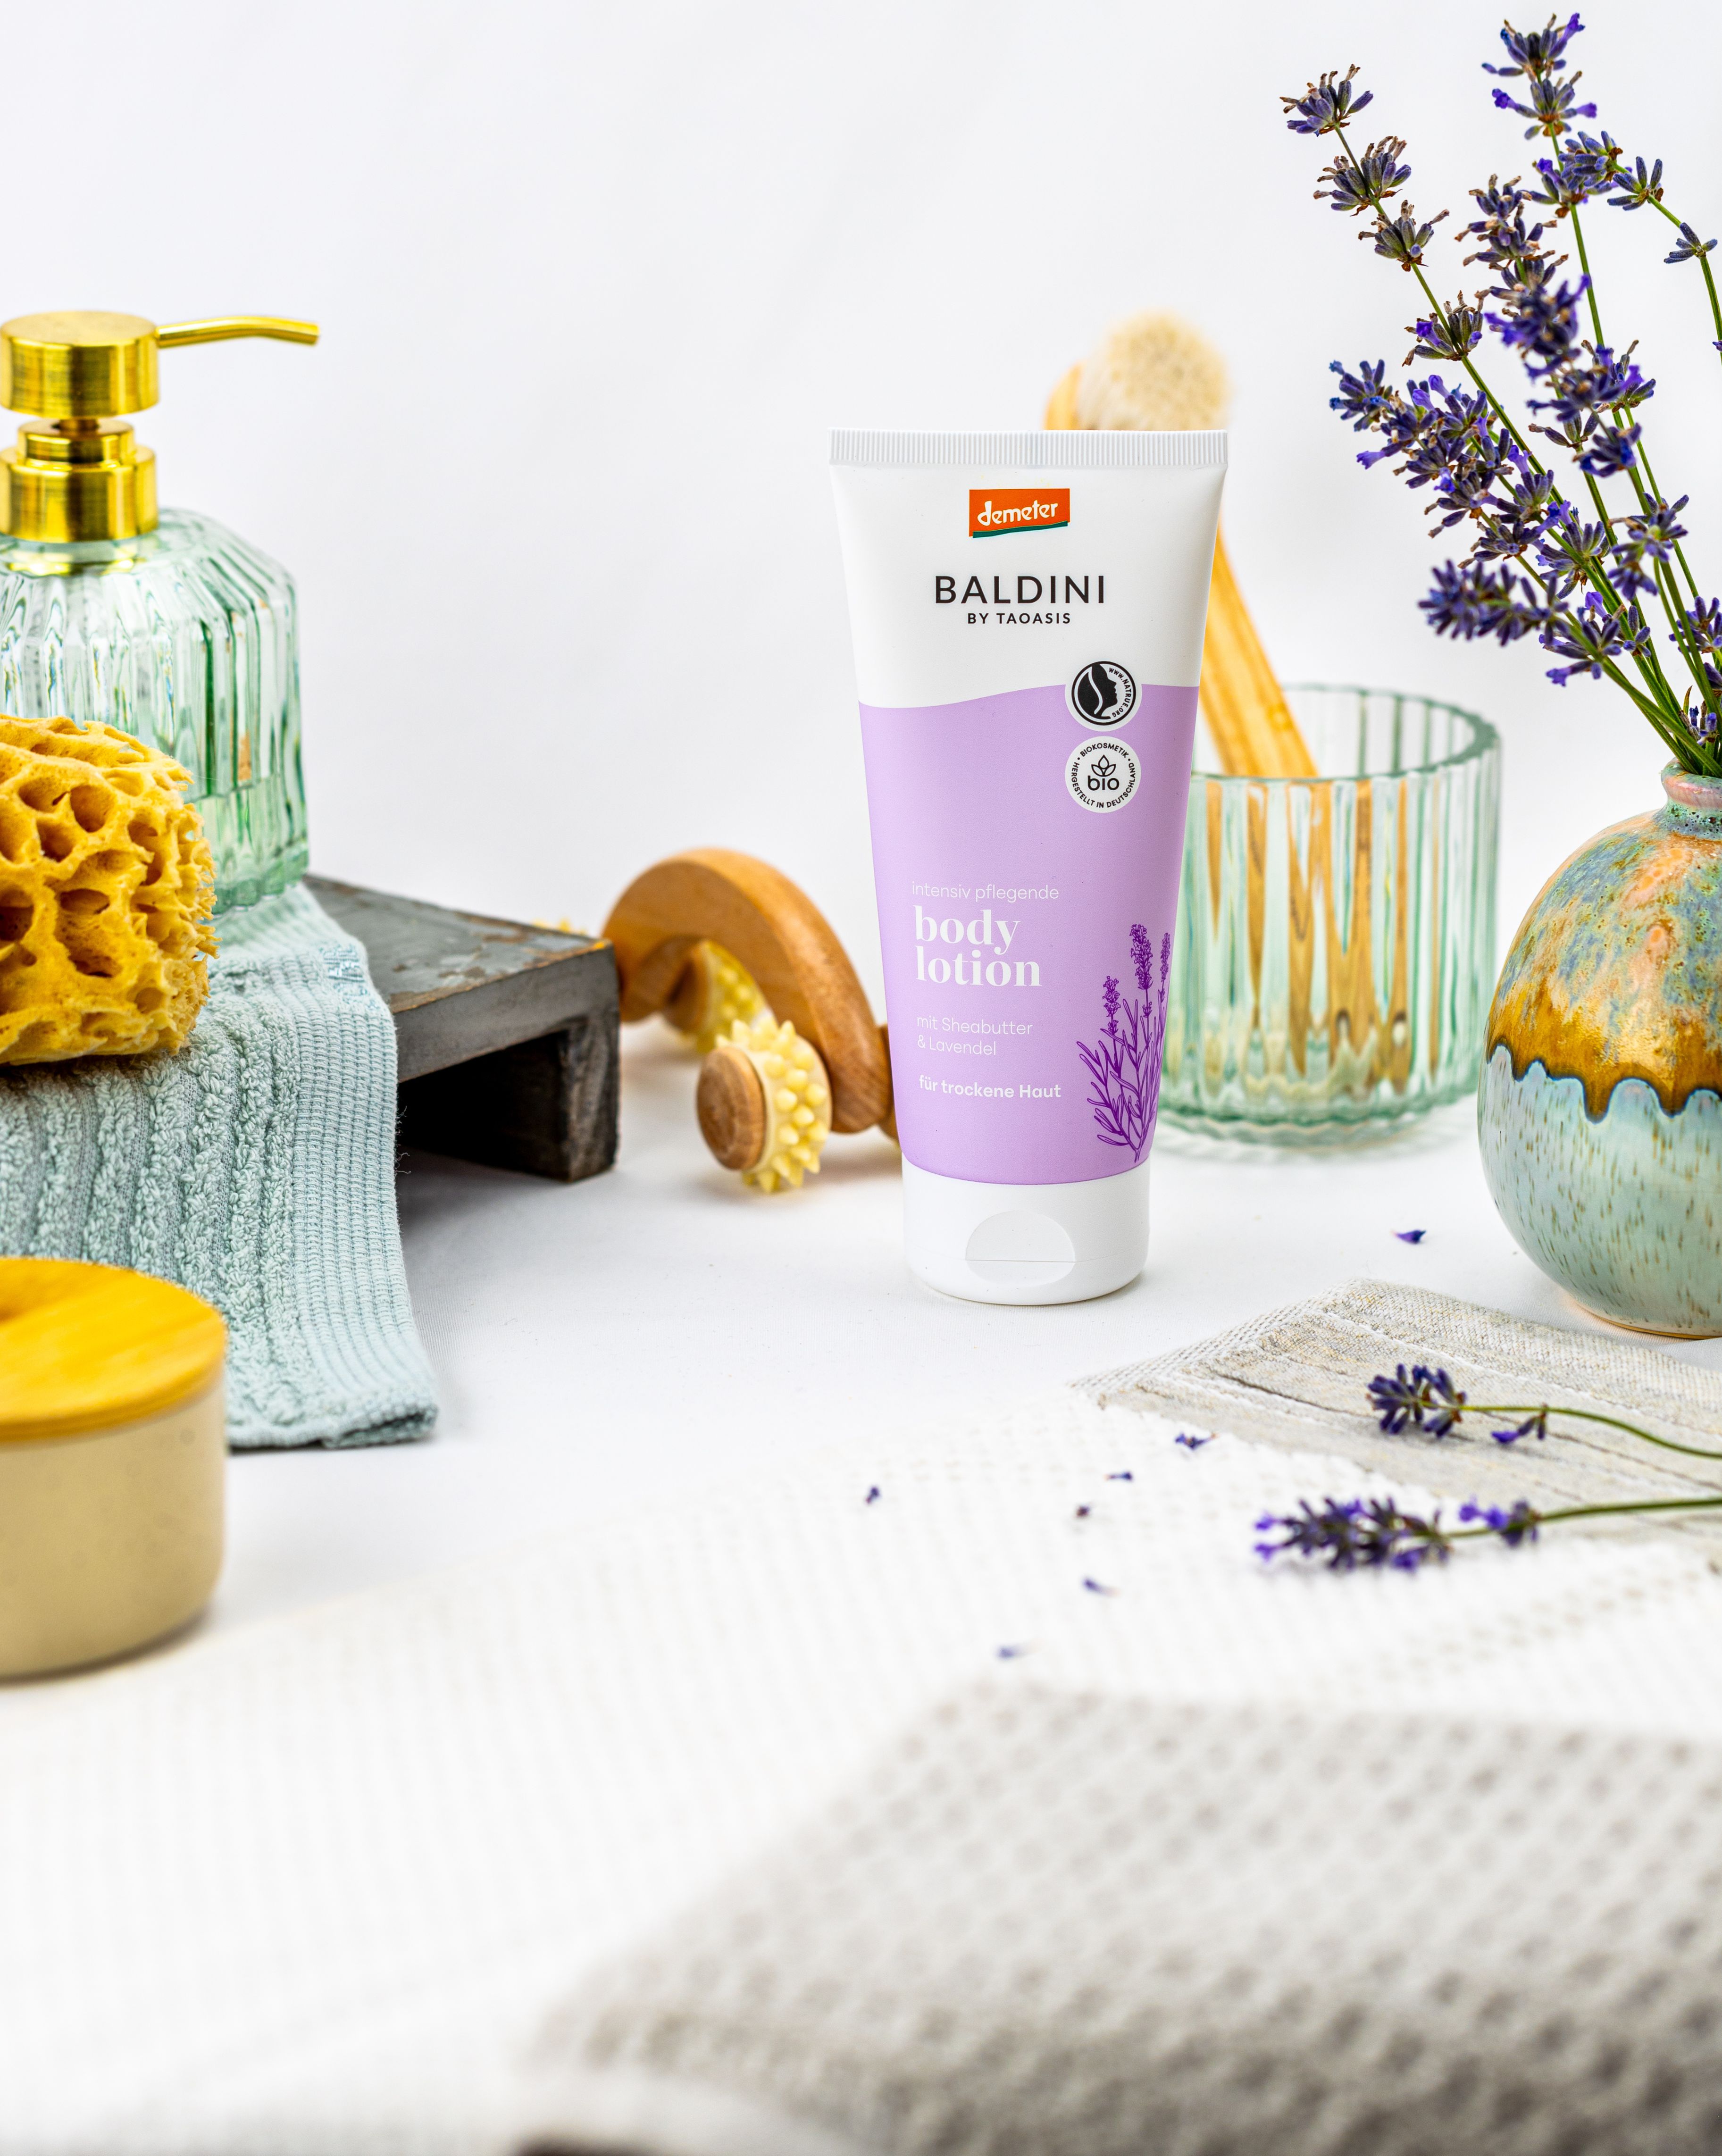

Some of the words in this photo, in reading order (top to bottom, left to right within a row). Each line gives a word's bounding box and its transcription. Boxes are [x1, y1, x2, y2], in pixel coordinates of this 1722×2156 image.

[977, 500, 1058, 526] demeter
[935, 575, 1105, 604] BALDINI
[967, 612, 990, 625] BY
[996, 612, 1071, 625] TAOASIS
[1109, 667, 1131, 718] WWW.NATRUE.ORG
[1079, 743, 1129, 759] BIOKOSMETIK
[1071, 762, 1095, 806] HERGESTELLT
[1106, 762, 1136, 808] DEUTSCHLAND
[1087, 775, 1120, 791] bio
[911, 880, 971, 899] intensiv
[975, 884, 1060, 903] pflegende
[913, 905, 1020, 955] body
[915, 945, 1042, 987] lotion
[916, 1016, 938, 1030] mit
[941, 1017, 1033, 1035] Sheabutter
[917, 1034, 927, 1049] &
[929, 1036, 997, 1056] Lavendel
[919, 1074, 939, 1092] für
[941, 1080, 1014, 1098] trockene
[1019, 1084, 1062, 1099] Haut
